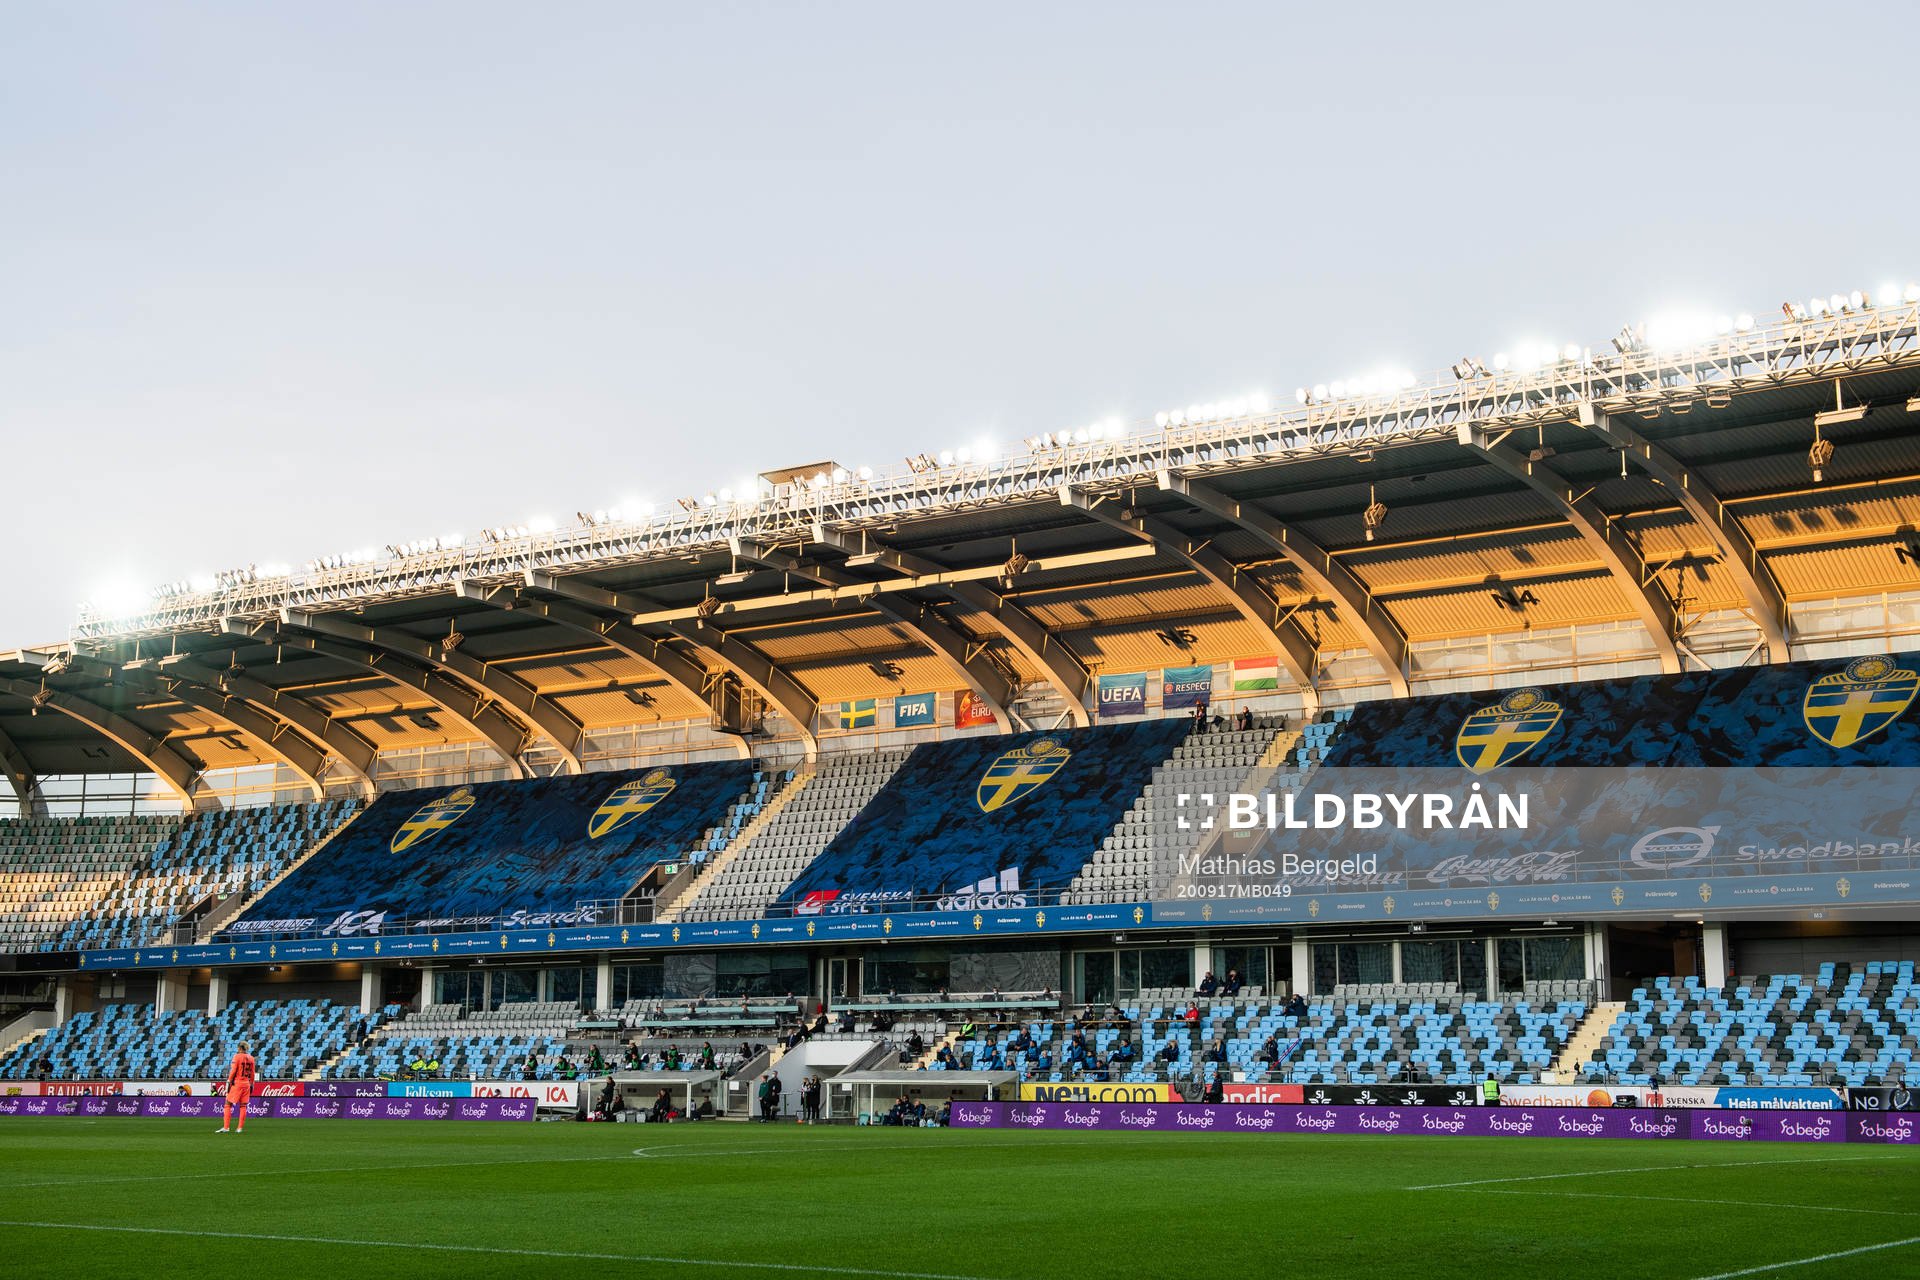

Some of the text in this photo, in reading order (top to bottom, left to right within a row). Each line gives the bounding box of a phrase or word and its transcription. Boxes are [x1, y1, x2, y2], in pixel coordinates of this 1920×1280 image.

[1175, 681, 1210, 693] RESPECT
[1101, 687, 1142, 702] UEFA
[899, 703, 927, 717] FIFA
[971, 707, 991, 718] EURO
[841, 891, 912, 902] SVENSKA
[937, 892, 1027, 911] adidas
[831, 901, 869, 914] SPEL
[322, 910, 388, 936] ICA
[405, 1086, 454, 1097] Folksam
[475, 1086, 494, 1097] ICA
[510, 1087, 530, 1097] ICA
[546, 1087, 568, 1102] ICA
[1316, 1090, 1324, 1099] SJ
[1361, 1091, 1370, 1099] SJ
[1408, 1091, 1417, 1100] SJ
[1456, 1091, 1466, 1100] SJ
[1500, 1094, 1583, 1106] Swedbank
[1728, 1097, 1833, 1109] Heja målvakten!
[26, 1102, 46, 1114] Fabege
[148, 1102, 169, 1114] Fabege
[280, 1102, 302, 1115] Fabege
[350, 1102, 373, 1116] Fabege
[386, 1103, 410, 1117] Fabege
[424, 1104, 448, 1118] Fabege
[462, 1104, 486, 1118] Fabege
[500, 1104, 526, 1118] Fabege
[958, 1108, 991, 1124] Fabege
[1010, 1109, 1044, 1126] Fabege
[1064, 1110, 1099, 1126] Fabege
[1120, 1110, 1155, 1127] Fabege
[1176, 1110, 1214, 1128] Fabege
[1236, 1111, 1273, 1129] Fabege
[1296, 1112, 1335, 1130] Fabege
[1359, 1113, 1399, 1131] Fabege
[1422, 1114, 1464, 1132] Fabege
[1489, 1114, 1532, 1133] Fabege
[1558, 1115, 1603, 1134] Fabege
[1630, 1116, 1676, 1137] Fabege
[1704, 1118, 1752, 1138] Fabege
[1780, 1118, 1830, 1140] Fabege
[1860, 1120, 1911, 1140] Fabege
